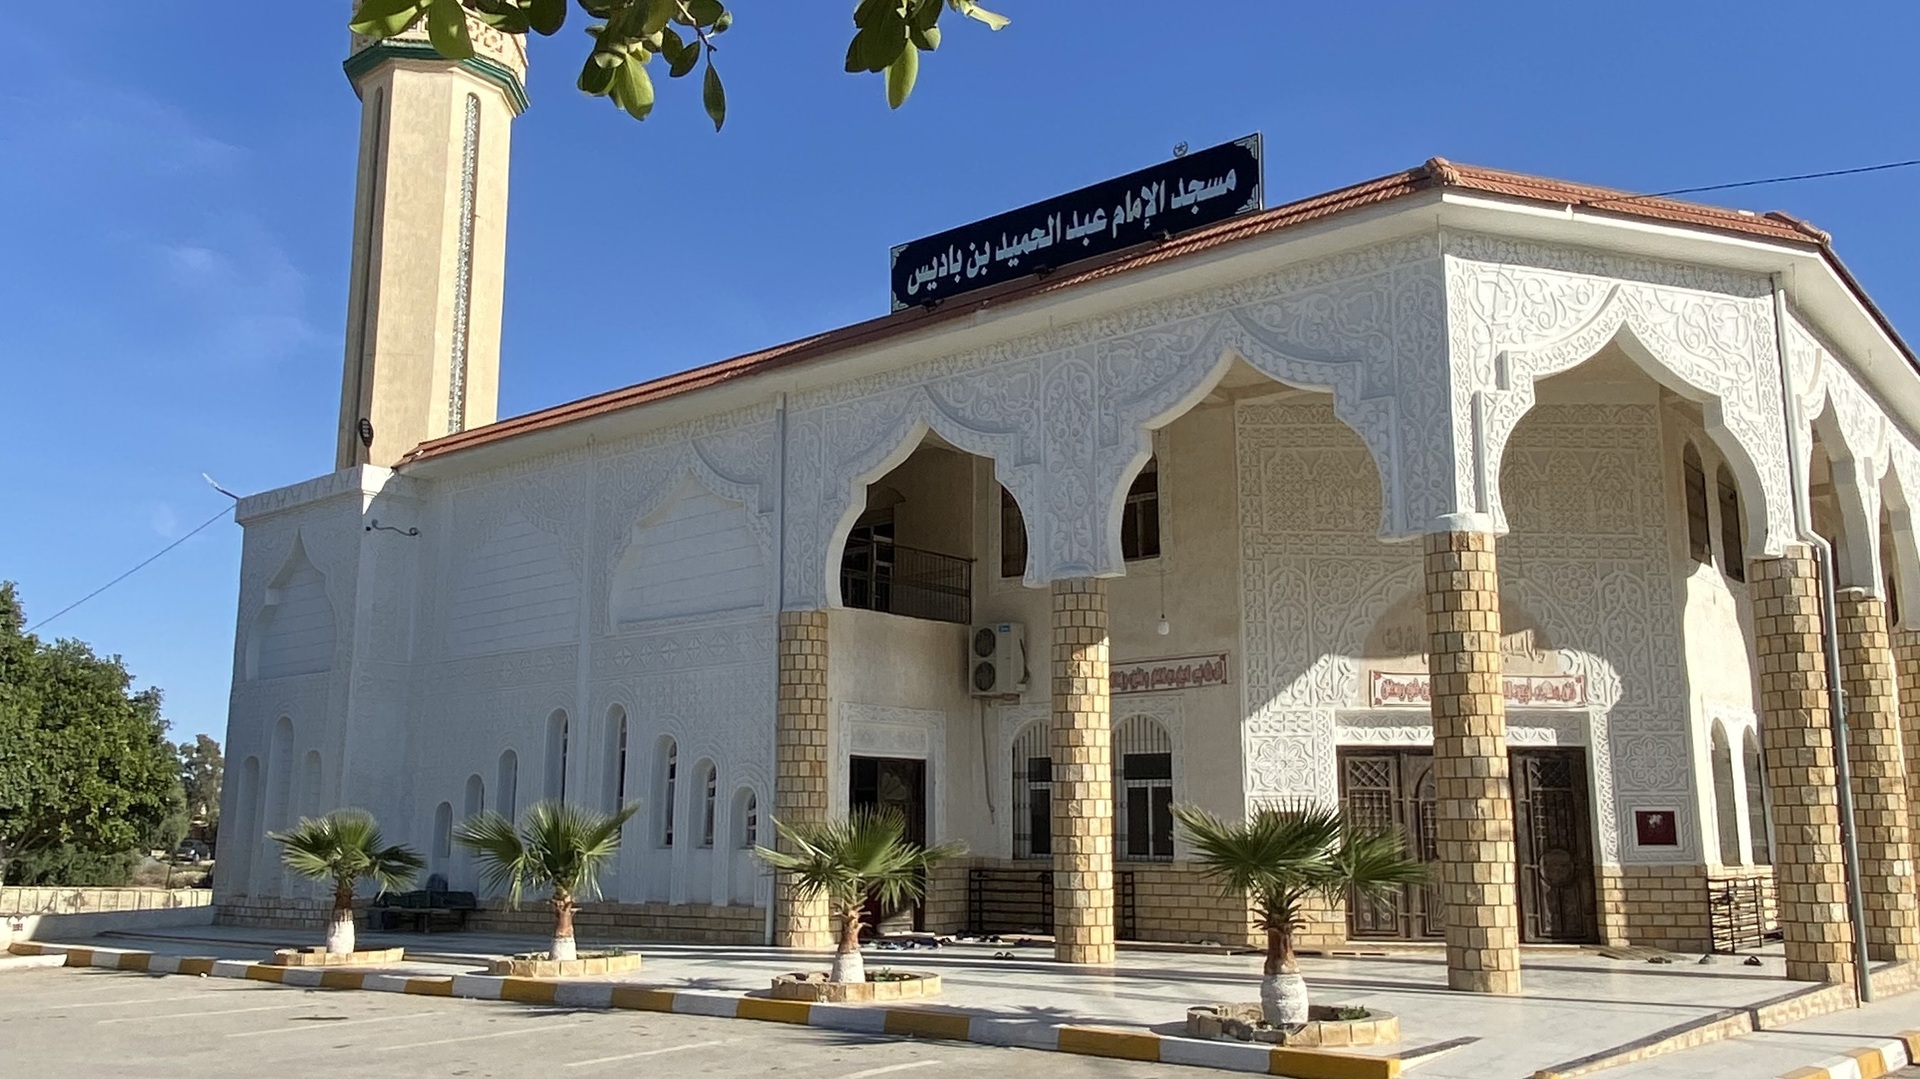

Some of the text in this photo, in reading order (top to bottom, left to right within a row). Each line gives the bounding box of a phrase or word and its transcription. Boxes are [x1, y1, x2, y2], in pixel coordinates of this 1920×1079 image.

[907, 168, 1237, 295] مسجد الإمام عبد الحميد بن باديس
